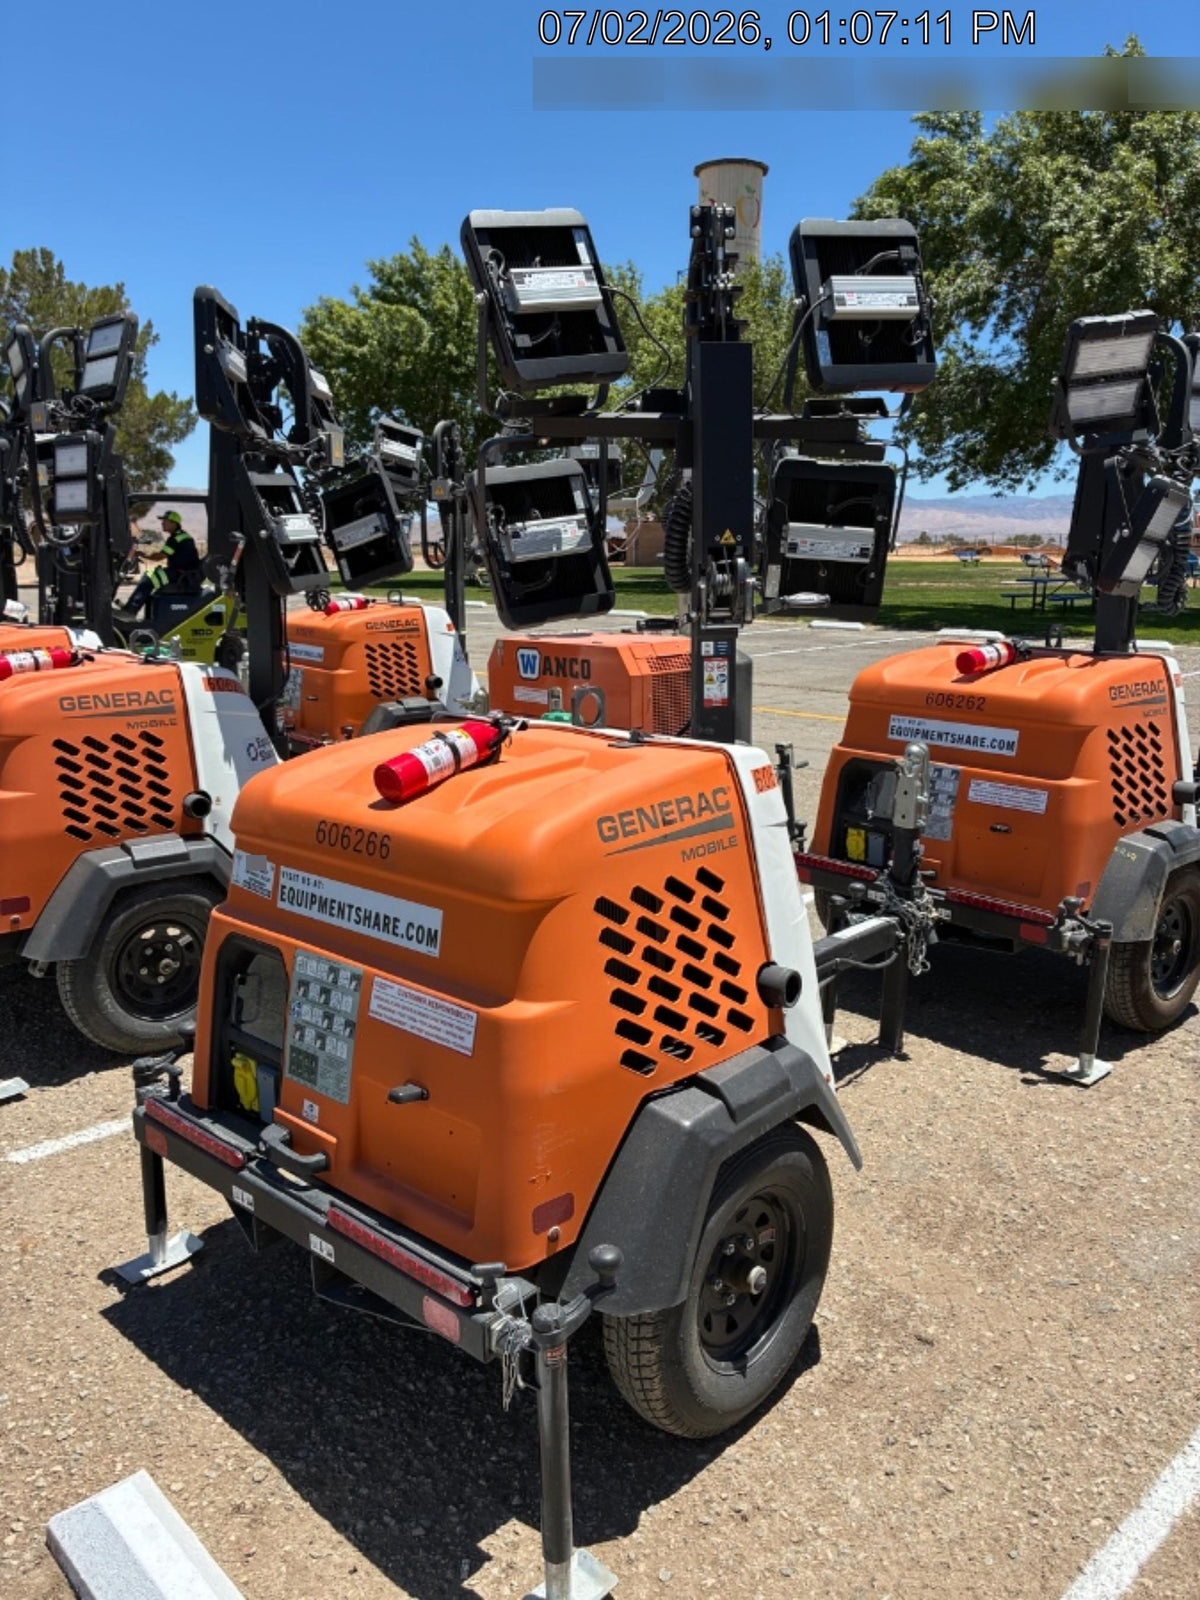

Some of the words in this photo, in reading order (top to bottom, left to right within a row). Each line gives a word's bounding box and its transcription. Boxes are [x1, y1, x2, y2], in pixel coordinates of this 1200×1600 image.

[366, 618, 419, 630] GENERAC
[517, 648, 592, 681] WANCO
[59, 689, 175, 712] GENERAC
[925, 692, 986, 711] 606262
[1109, 680, 1166, 701] GENERAC
[126, 718, 178, 730] MOBILE
[890, 725, 1016, 753] EQUIPMENTSHARE.COM
[596, 787, 731, 843] GENERAC
[315, 819, 392, 860] 606266
[681, 835, 738, 863] MOBILE
[281, 869, 300, 884] VISIT
[302, 876, 311, 887] US
[279, 884, 440, 949] EQUIPMENTSHARE.COM
